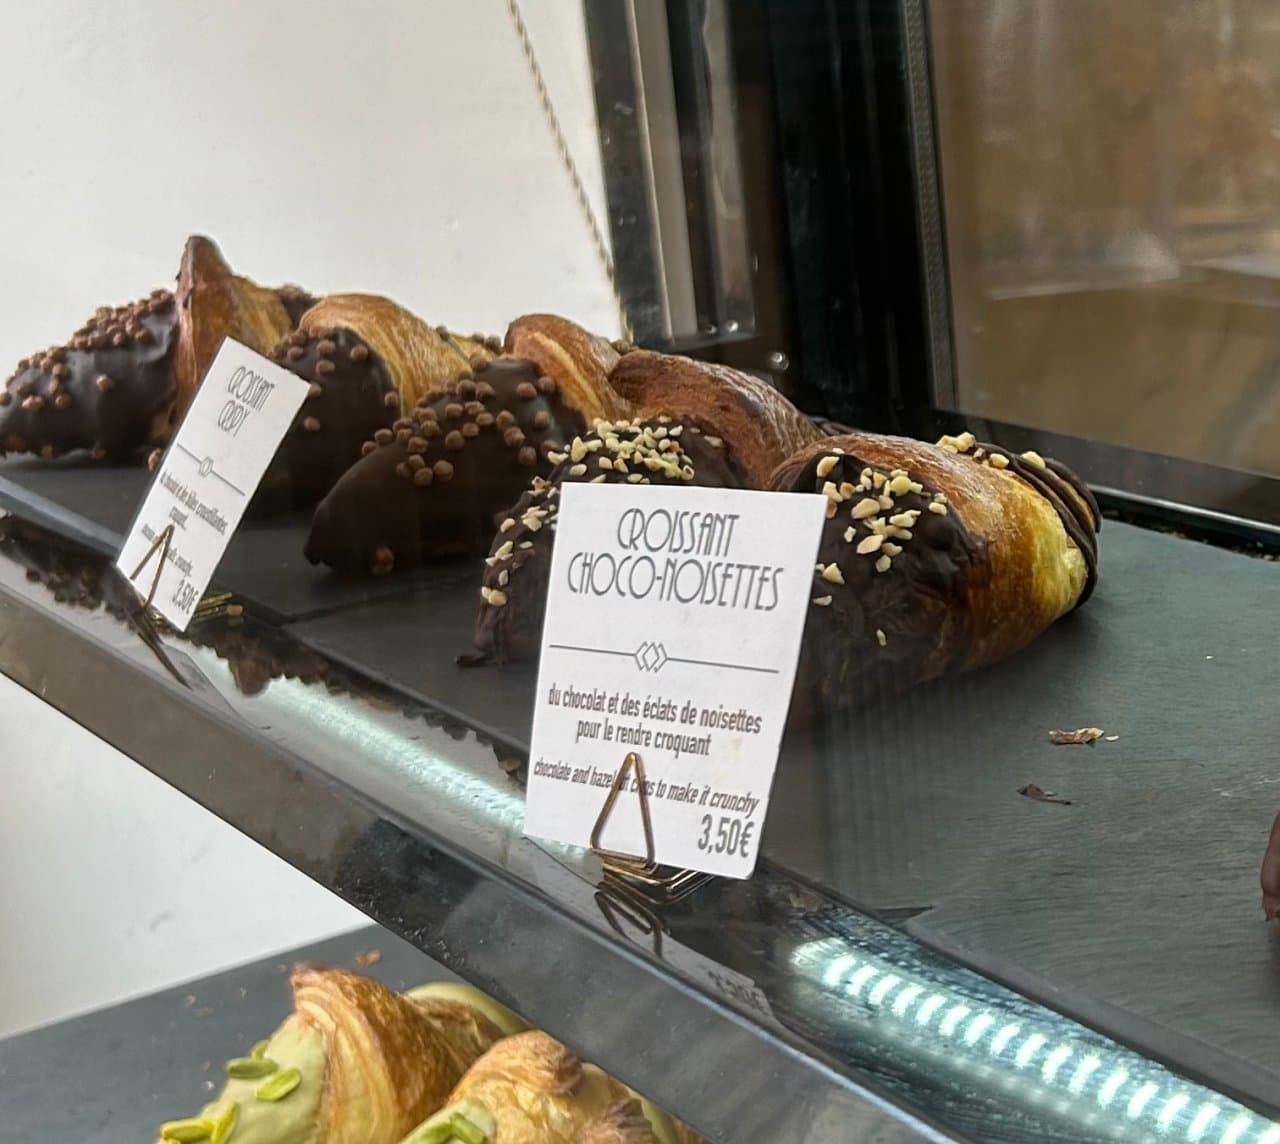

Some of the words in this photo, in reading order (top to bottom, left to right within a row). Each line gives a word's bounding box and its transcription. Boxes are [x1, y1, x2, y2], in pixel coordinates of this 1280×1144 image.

[617, 508, 740, 557] CROISSANT
[567, 552, 784, 611] CHOCO-NOISETTES
[548, 682, 561, 706] du
[562, 684, 606, 712] chocolat
[607, 692, 619, 715] et
[620, 691, 641, 717] des
[642, 694, 678, 722] éclats
[680, 700, 698, 726] de
[699, 703, 763, 734] noisettes
[575, 719, 602, 744] pour
[603, 717, 614, 742] le
[615, 722, 652, 748] rendre
[654, 731, 712, 759] croquant
[533, 756, 572, 781] chocolate
[571, 765, 592, 785] and
[656, 778, 667, 798] to
[667, 782, 699, 804] make
[699, 785, 711, 807] it
[710, 791, 760, 819] crunchy
[698, 813, 755, 858] 3,50€
